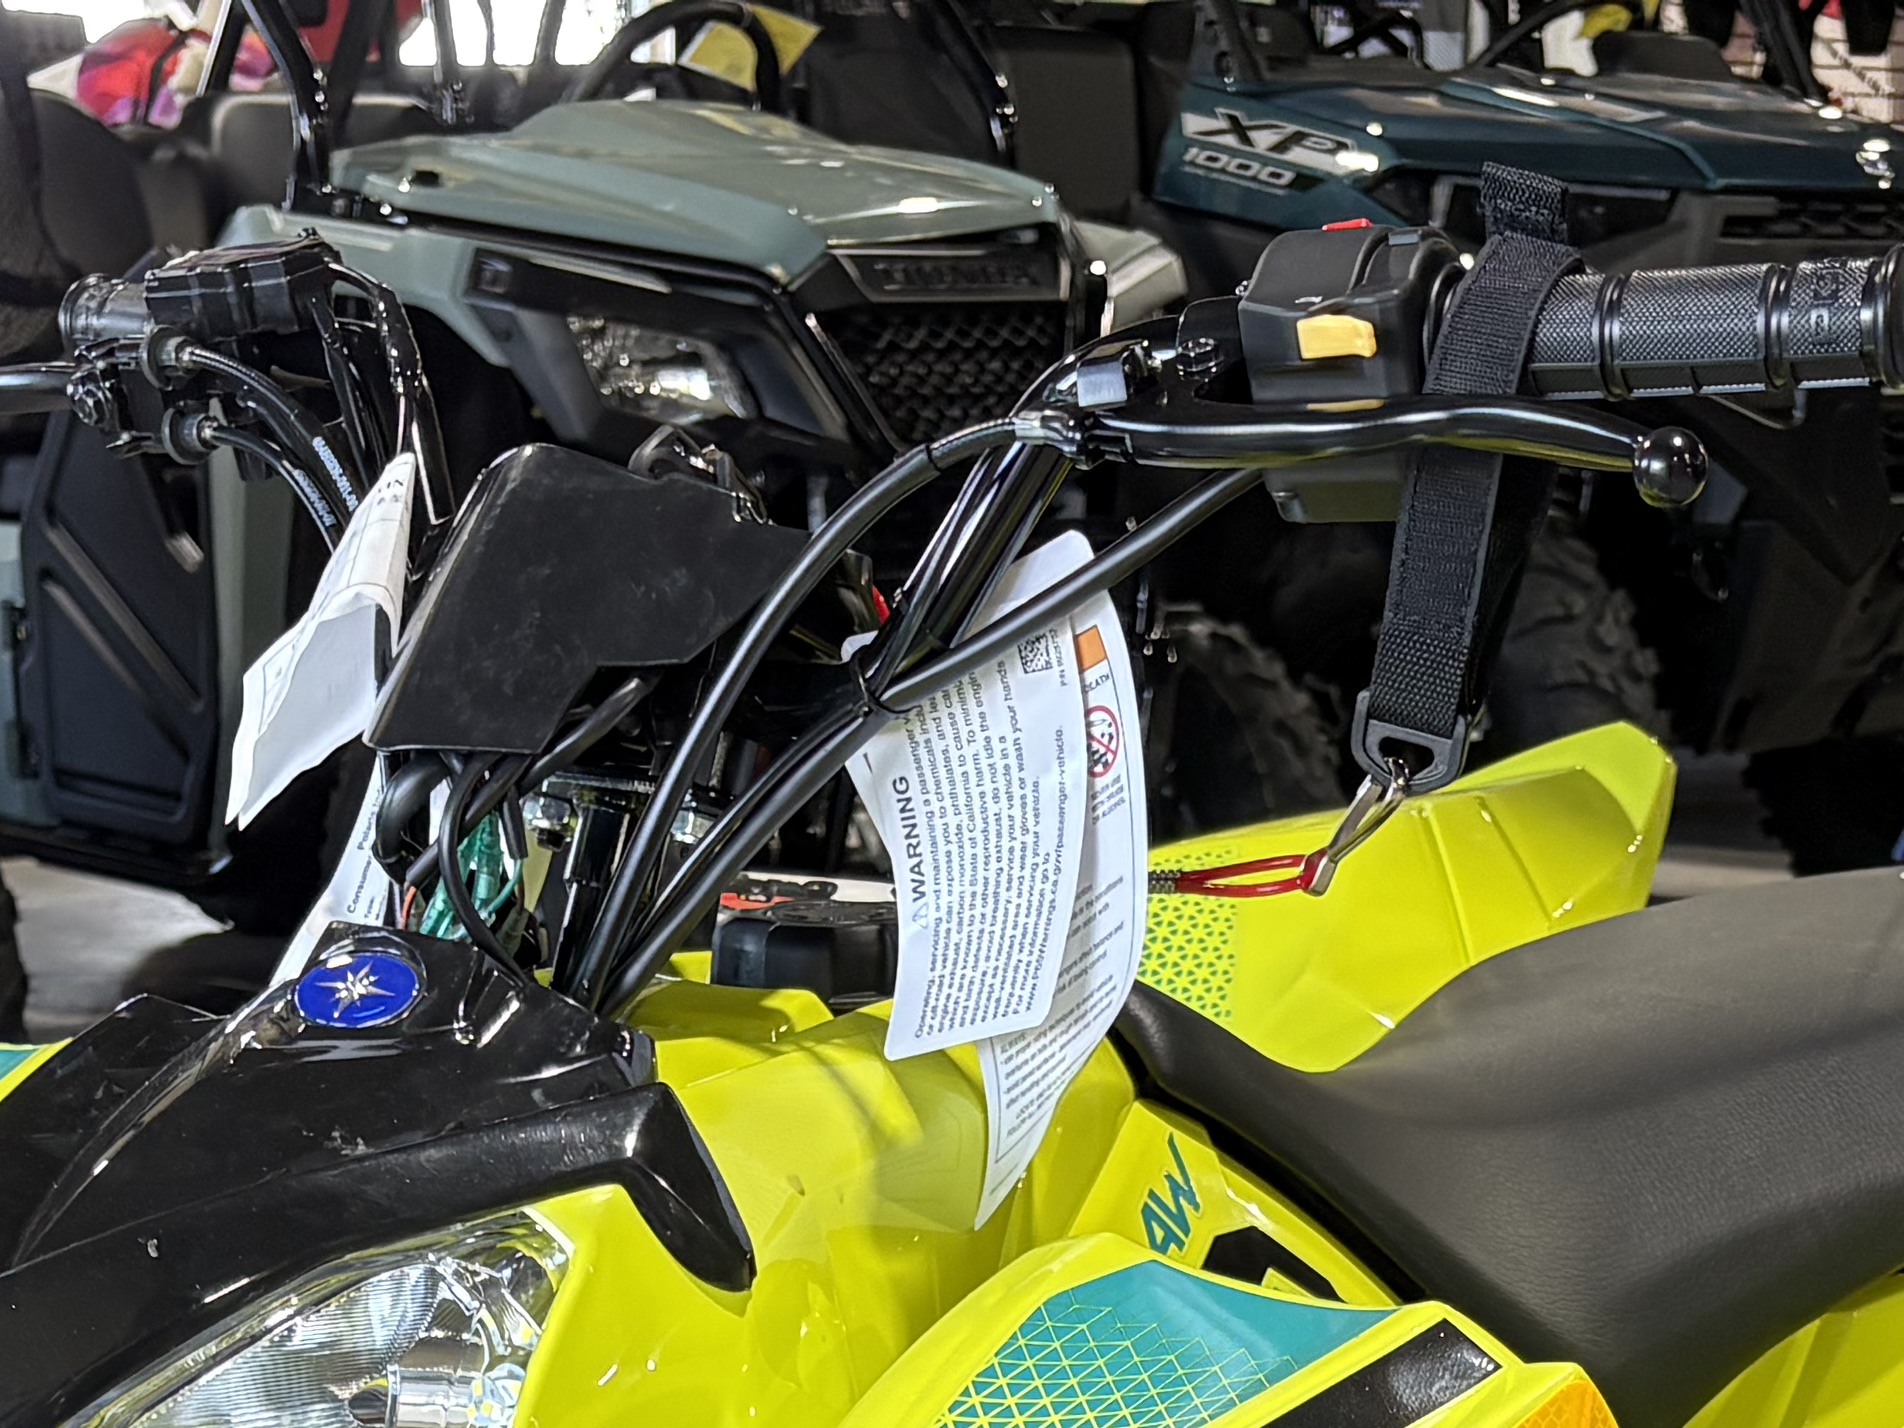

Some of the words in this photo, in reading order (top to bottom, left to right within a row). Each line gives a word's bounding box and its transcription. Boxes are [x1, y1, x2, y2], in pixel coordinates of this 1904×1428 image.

[1190, 108, 1358, 156] XP
[1183, 147, 1296, 187] 1000
[891, 775, 926, 902] WARNING
